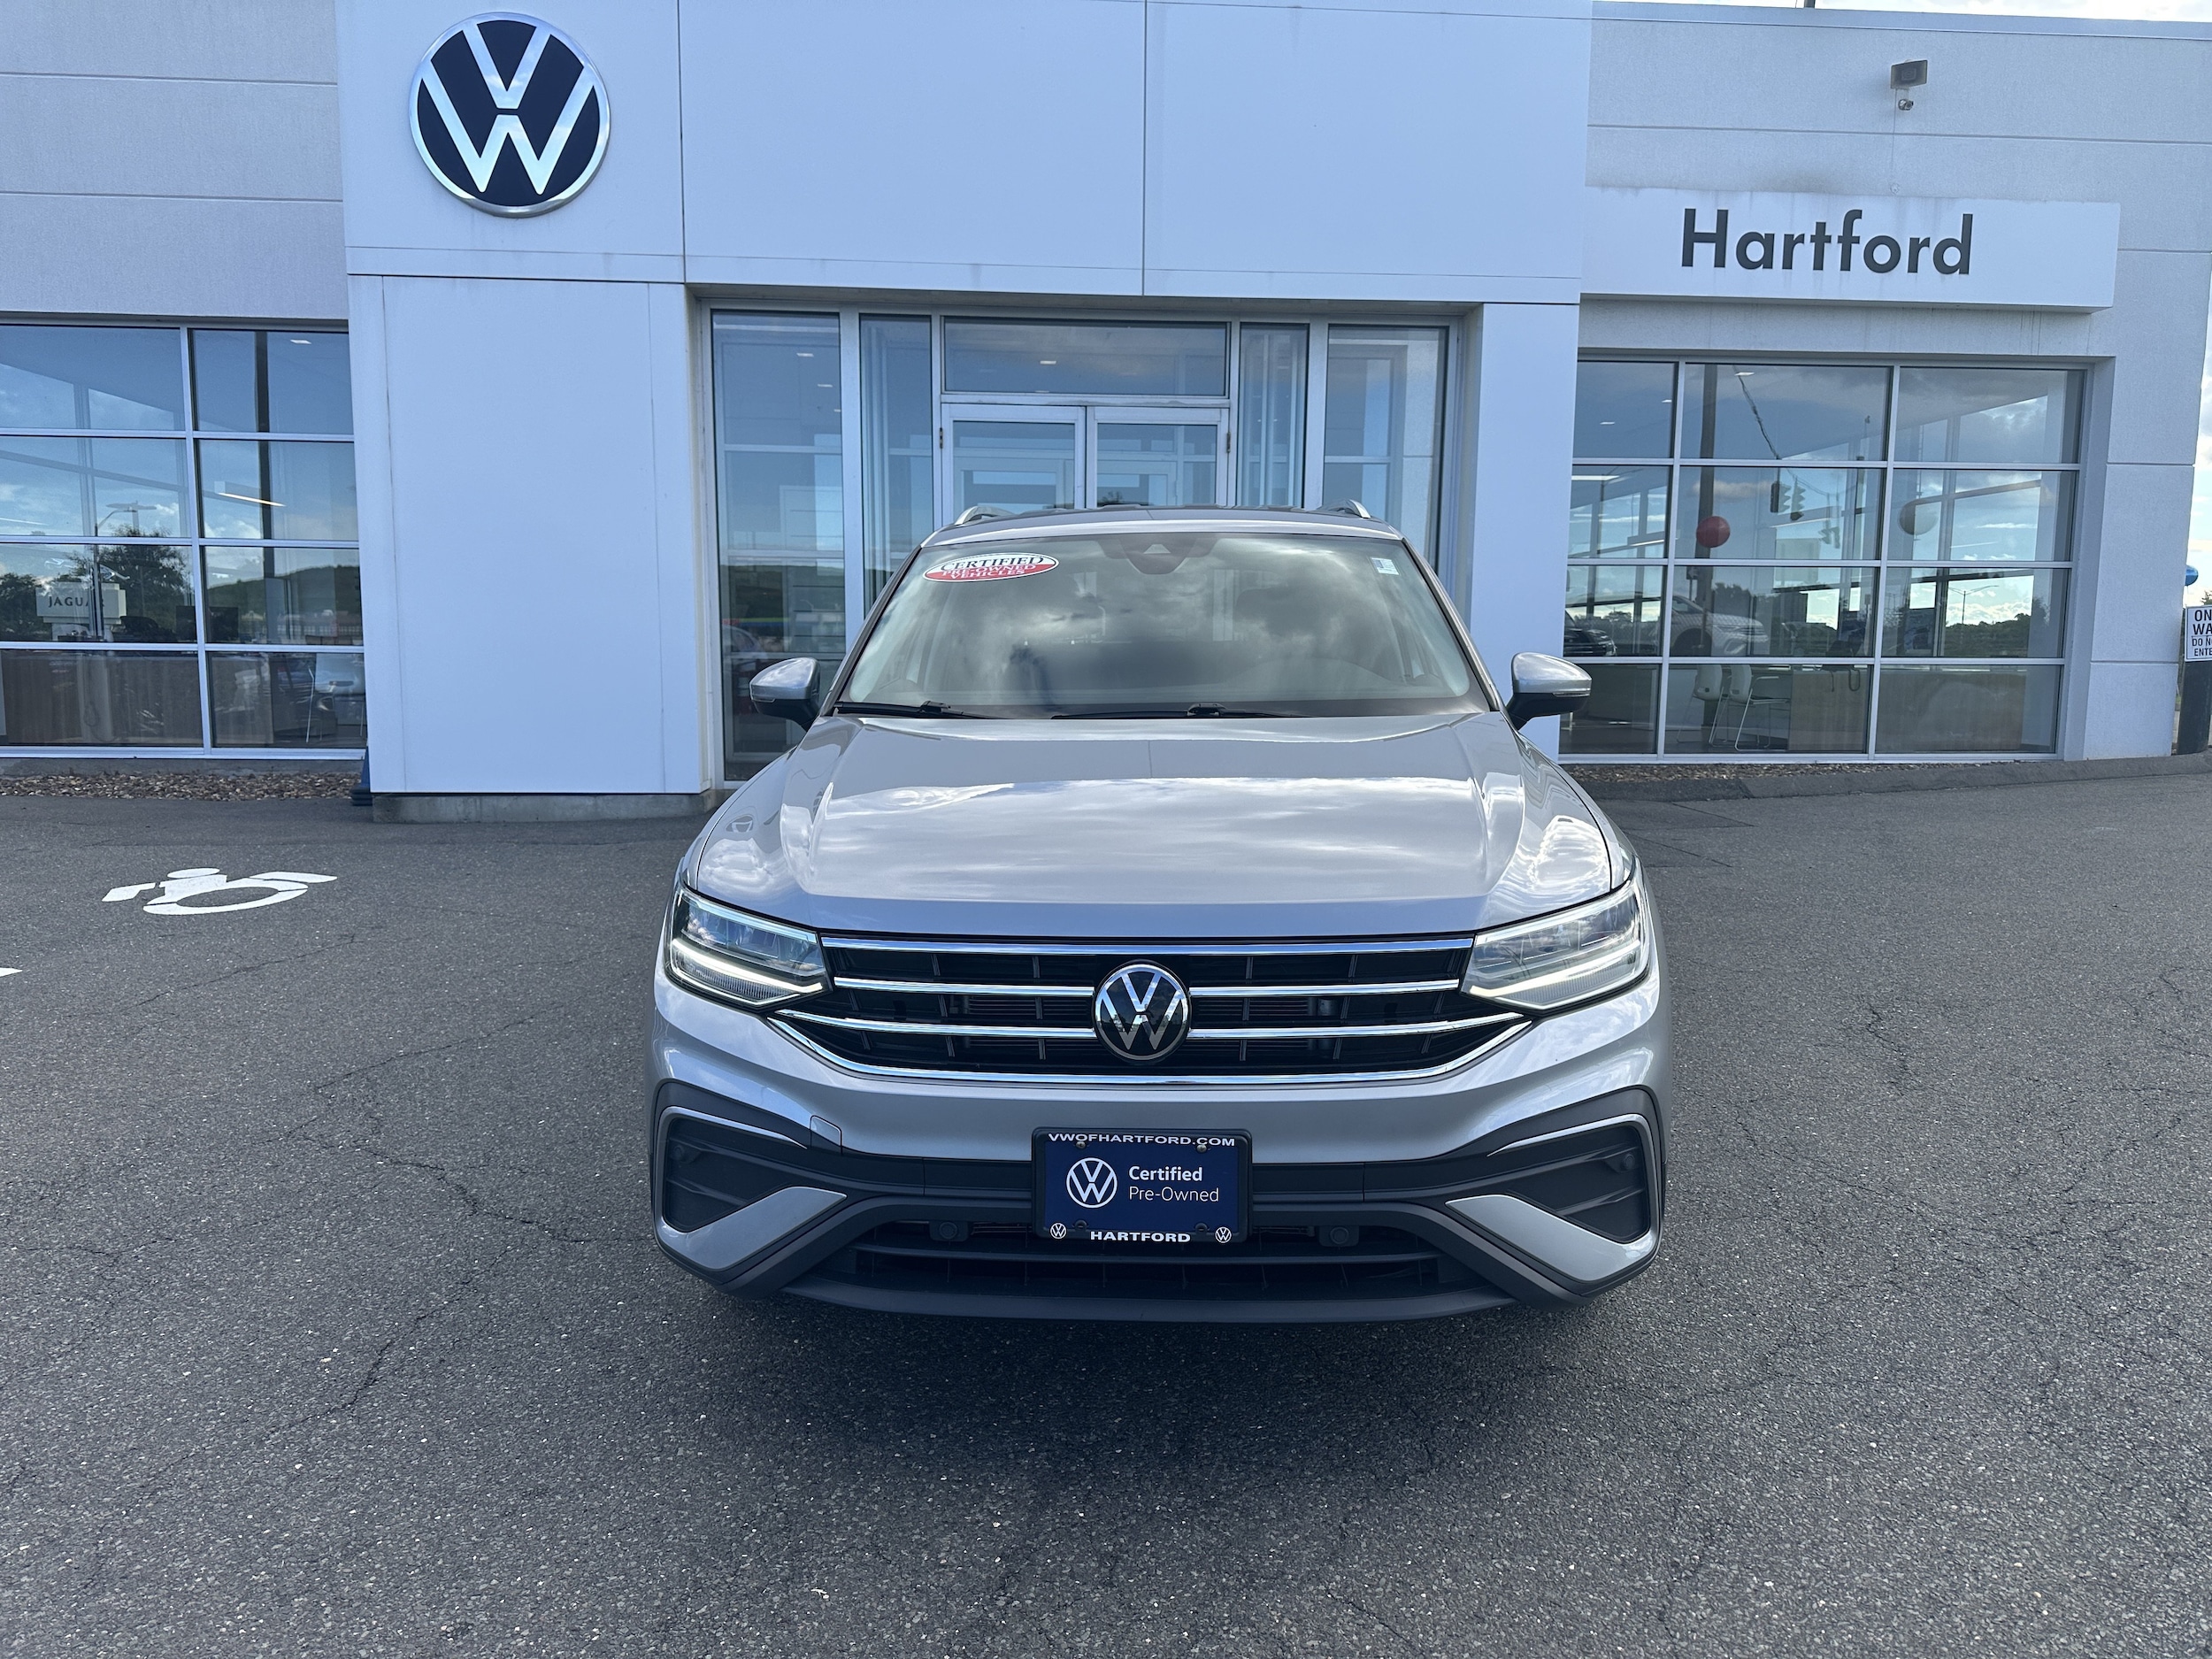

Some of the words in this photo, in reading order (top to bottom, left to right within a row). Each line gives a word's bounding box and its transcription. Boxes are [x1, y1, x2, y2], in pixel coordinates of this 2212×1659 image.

[1681, 208, 1973, 275] Hartford
[941, 557, 1044, 571] CERTIFIED
[942, 565, 1036, 576] PRE-OWNED
[951, 569, 1025, 580] VEHICLES
[48, 596, 104, 608] JAGU
[2206, 637, 2212, 646] N
[1048, 1133, 1235, 1147] VWOFHARTFORD.COM
[1128, 1166, 1202, 1181] Certified
[1129, 1187, 1219, 1202] Pre-Owned
[1090, 1231, 1191, 1242] HARTFORD
